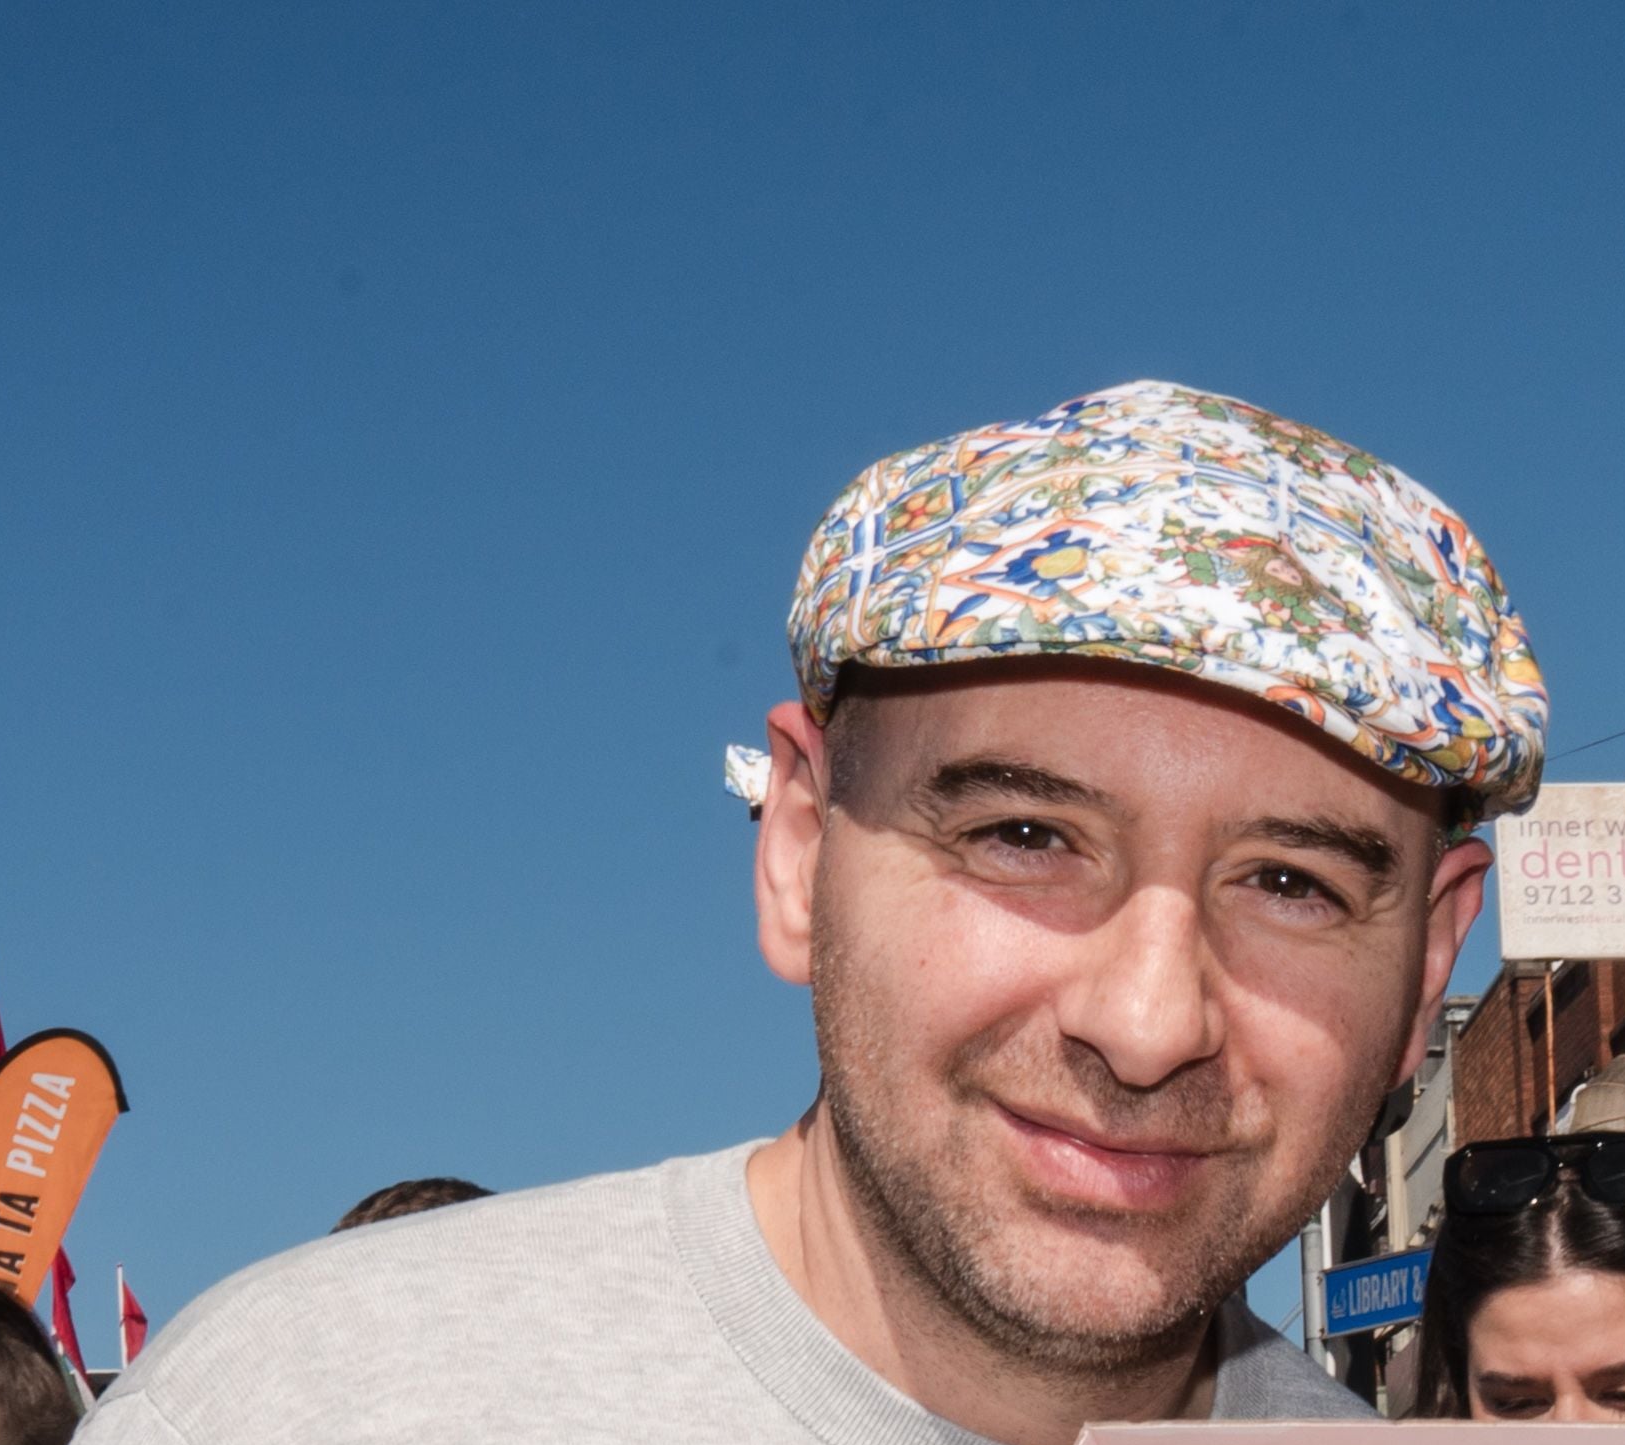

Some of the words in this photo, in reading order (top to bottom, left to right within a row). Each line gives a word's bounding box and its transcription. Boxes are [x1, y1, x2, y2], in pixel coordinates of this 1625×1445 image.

[1519, 817, 1593, 838] inner
[1524, 885, 1595, 905] 9712
[5, 1071, 76, 1178] PIZZA
[1349, 1266, 1409, 1317] LIBRARY
